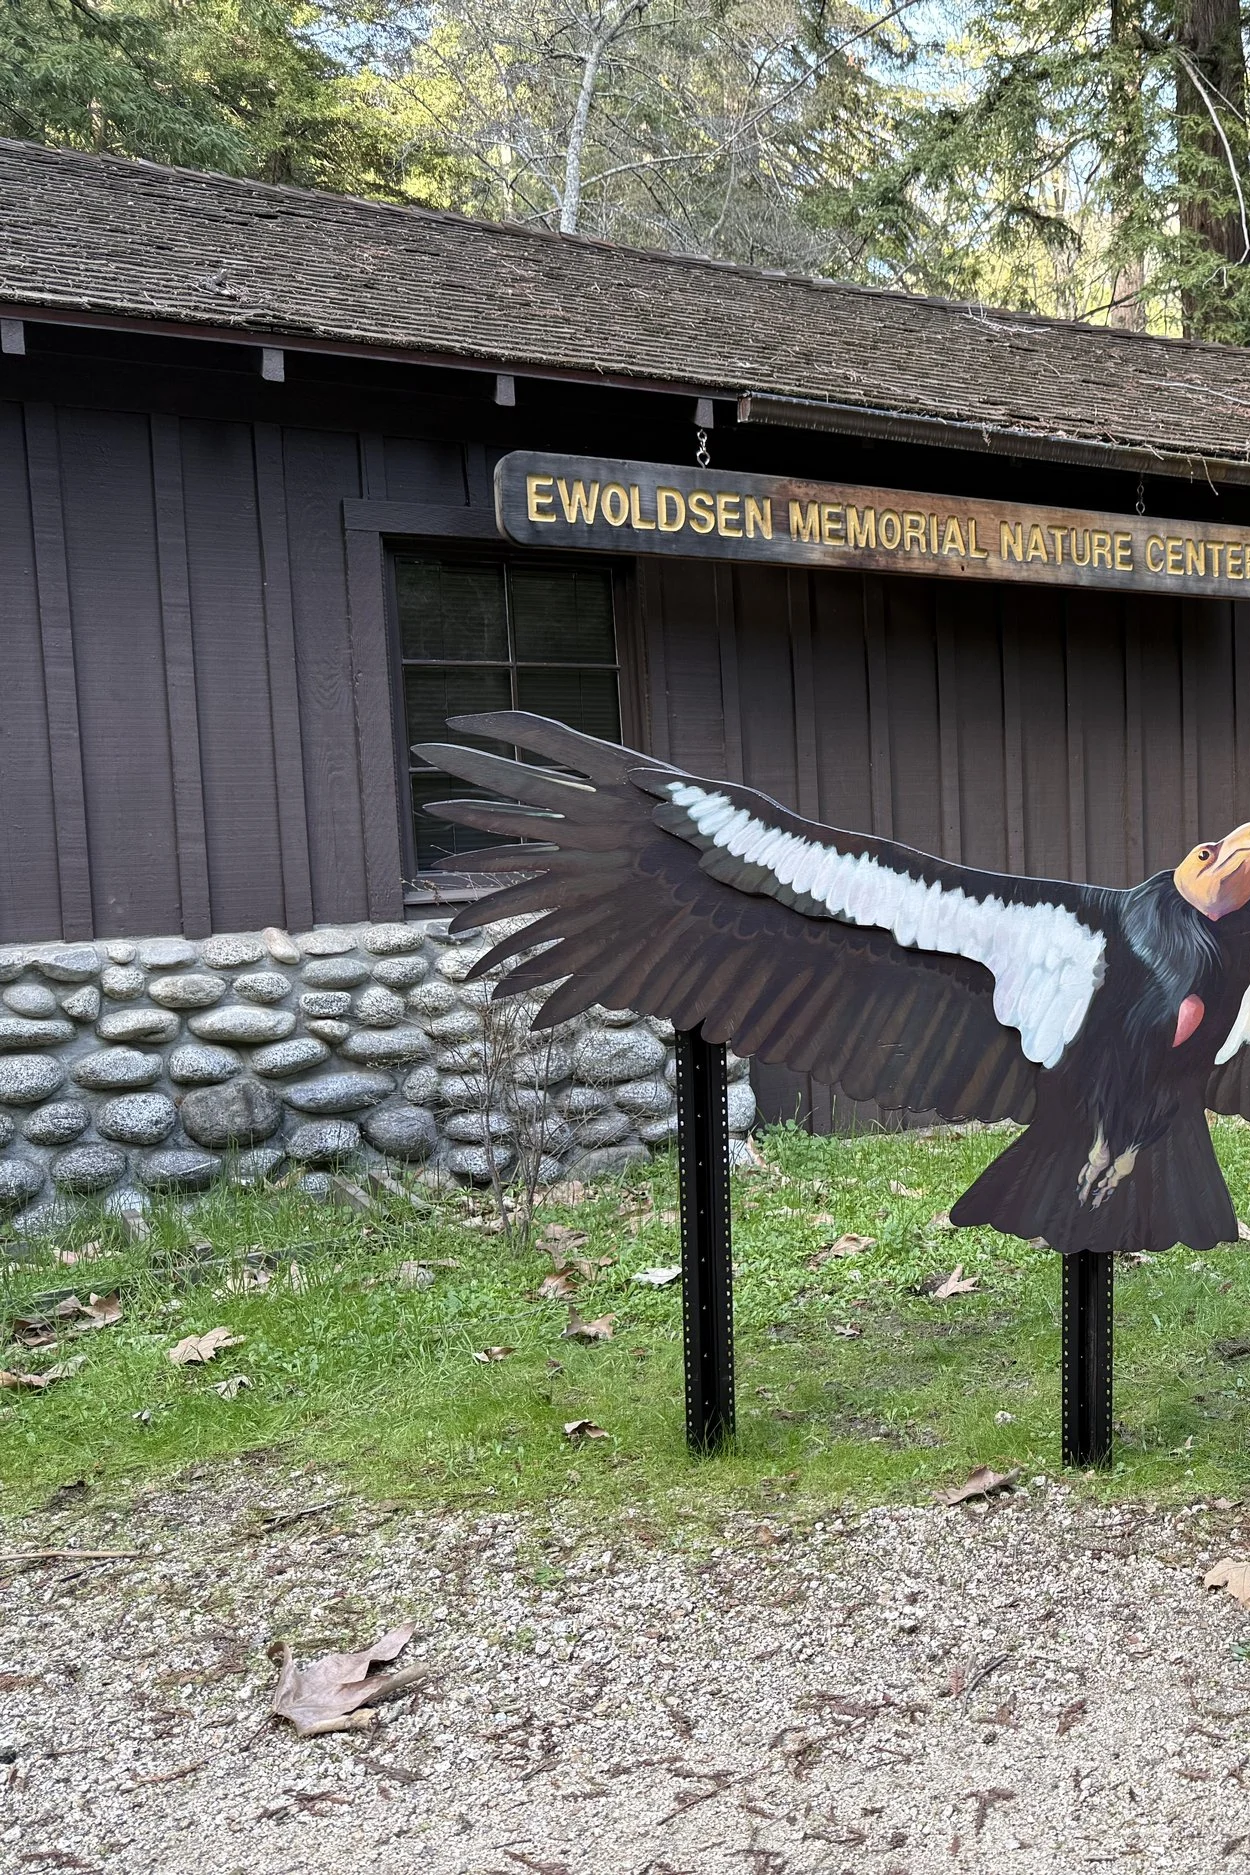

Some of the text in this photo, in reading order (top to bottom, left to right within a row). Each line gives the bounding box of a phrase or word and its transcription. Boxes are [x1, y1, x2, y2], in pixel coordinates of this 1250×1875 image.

[526, 474, 773, 540] EWOLDSEN
[788, 499, 989, 559] MEMORIAL
[1000, 520, 1133, 572] NATURE
